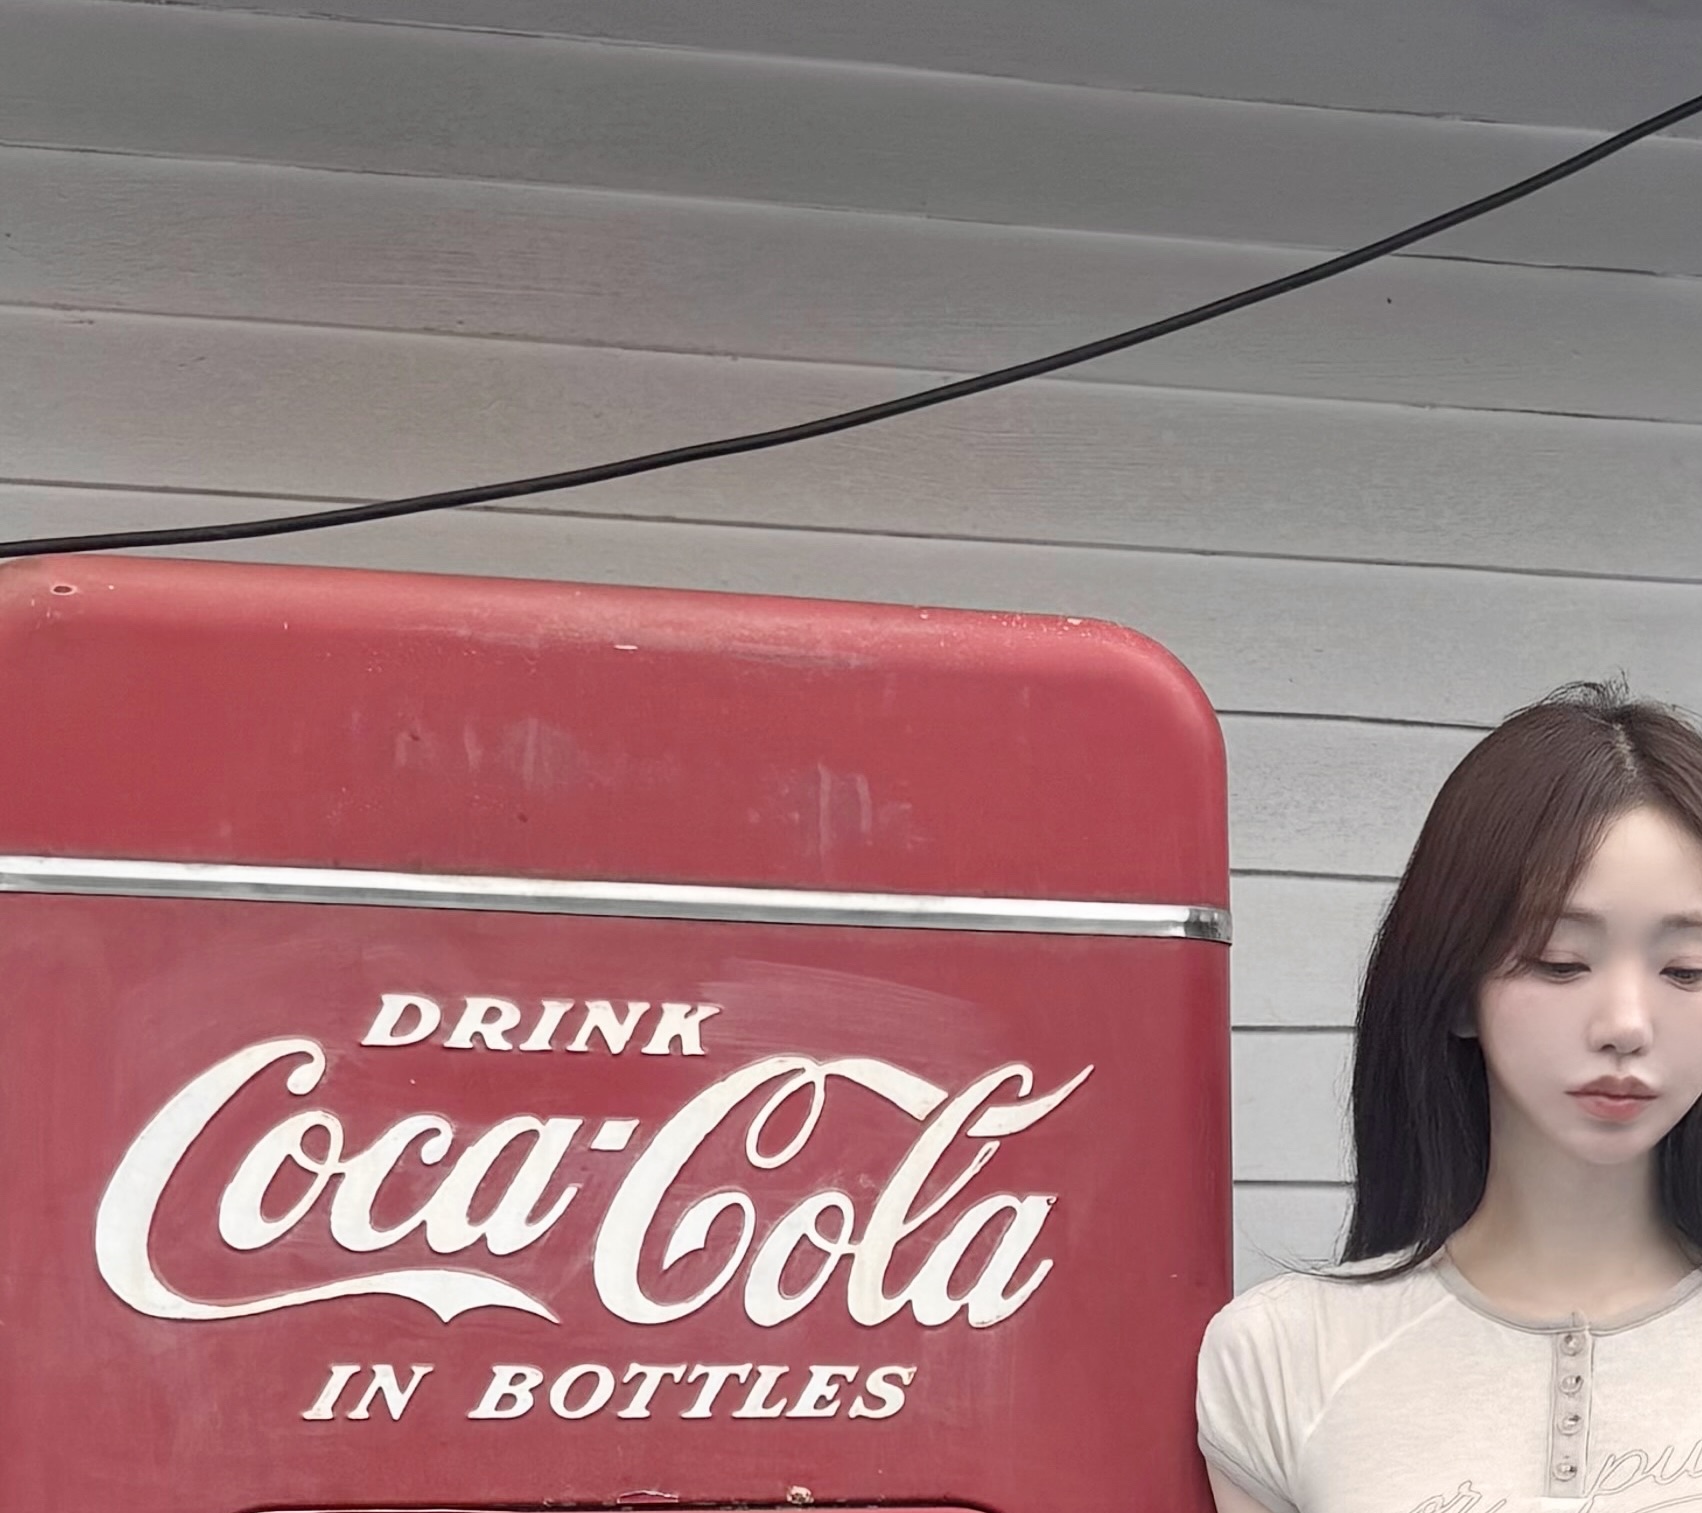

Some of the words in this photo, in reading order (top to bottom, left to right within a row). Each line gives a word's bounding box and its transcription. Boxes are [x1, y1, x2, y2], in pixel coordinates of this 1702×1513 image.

[361, 993, 723, 1057] DRINK
[95, 1036, 1095, 1326] Coca-Cola
[301, 1363, 434, 1421] IN
[467, 1362, 917, 1421] BOTTLES
